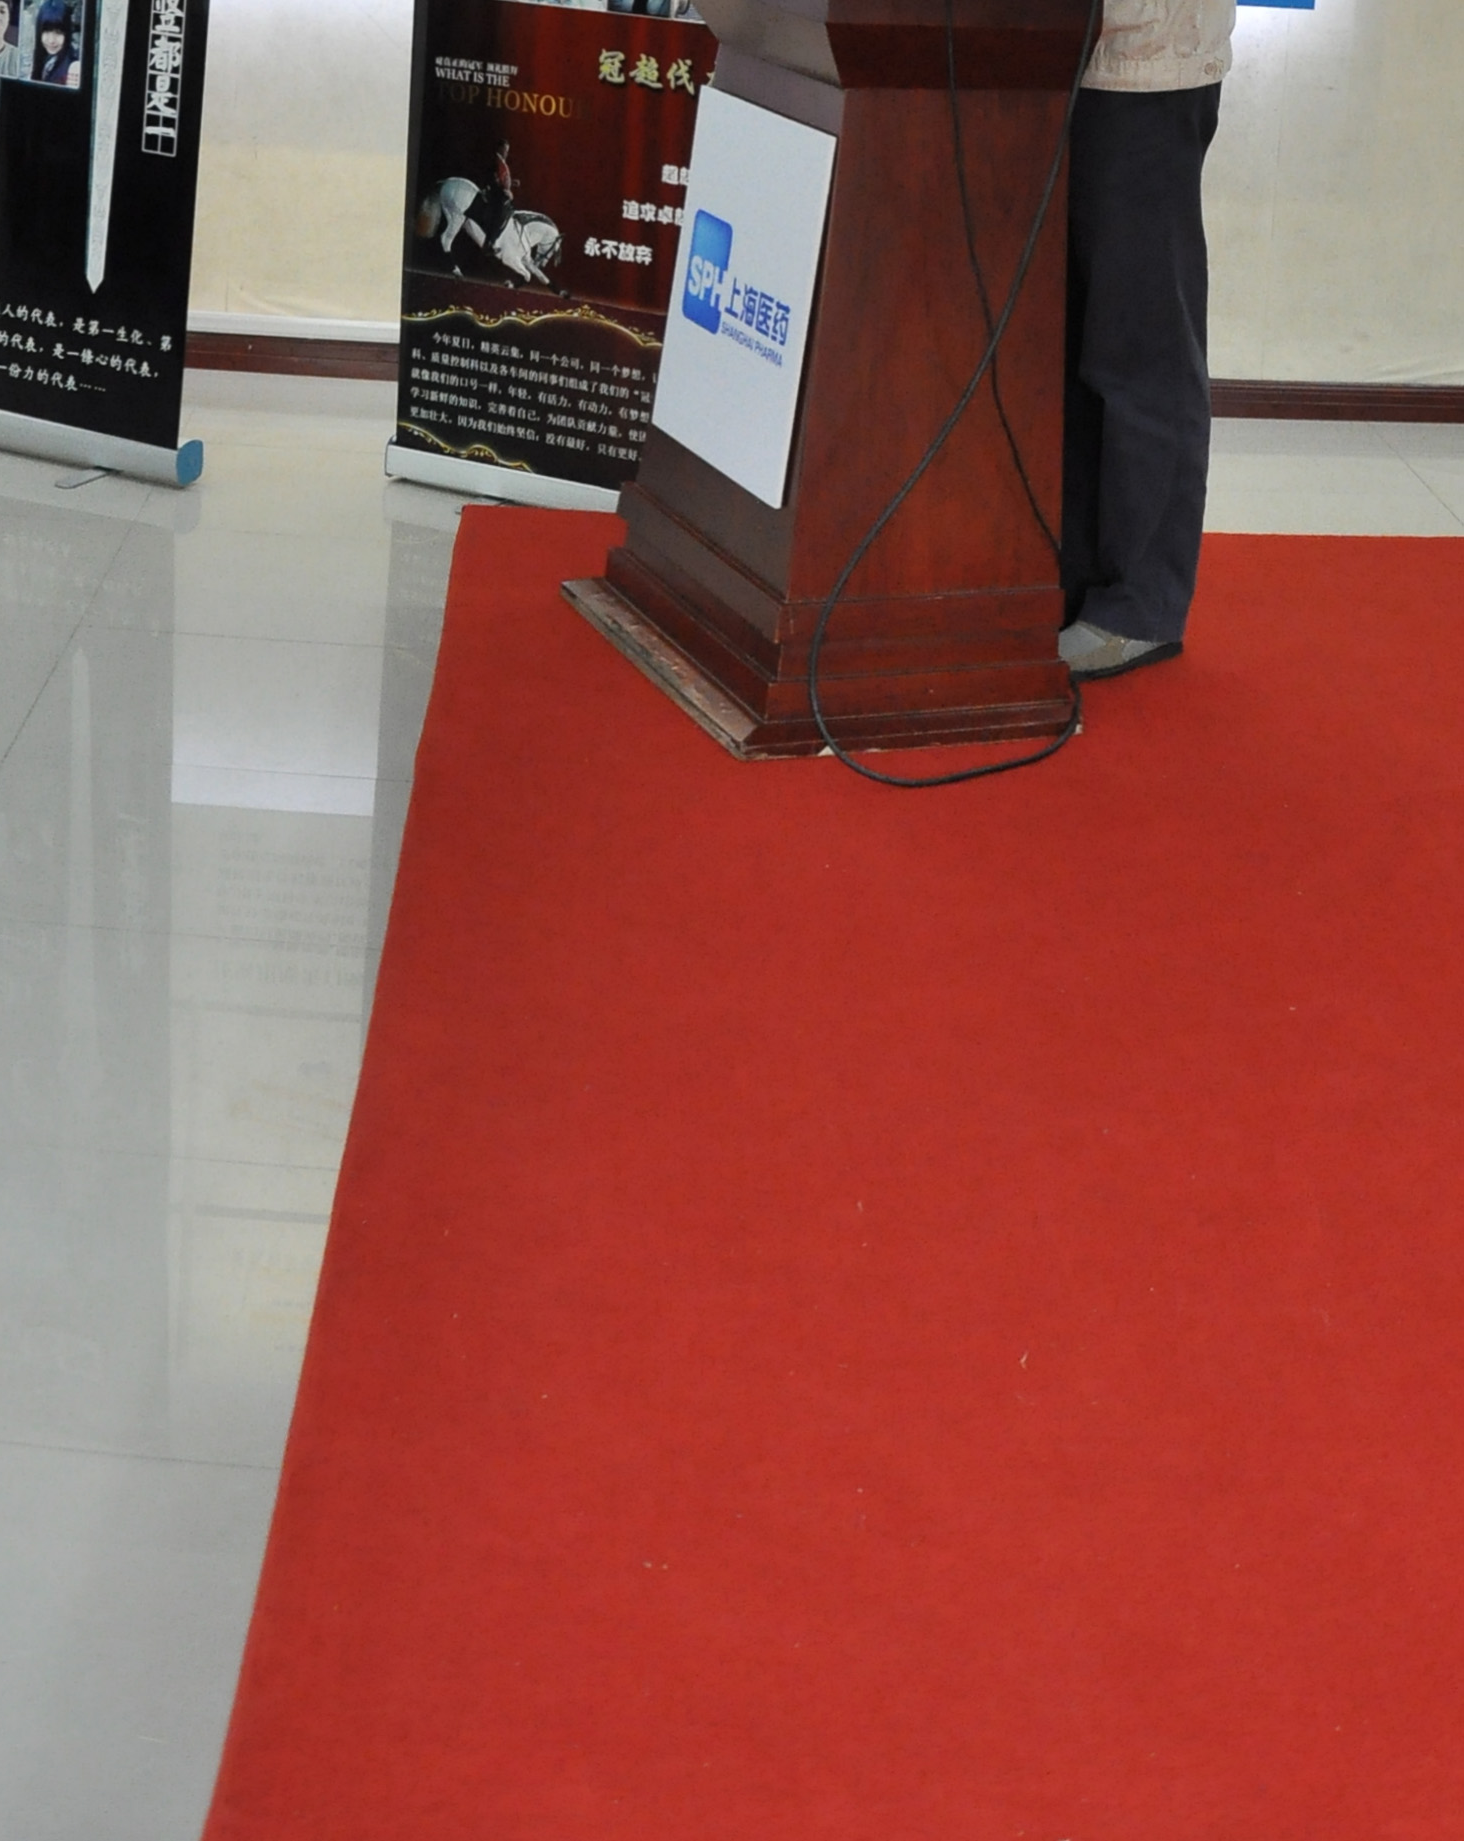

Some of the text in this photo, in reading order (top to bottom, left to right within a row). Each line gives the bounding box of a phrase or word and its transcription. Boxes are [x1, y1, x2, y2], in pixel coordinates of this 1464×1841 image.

[435, 66, 510, 88] WHAT IS THE
[584, 236, 653, 266] 永不放弃
[687, 254, 726, 308] SPH
[724, 276, 791, 347] 上海医药
[432, 332, 657, 385] 今年夏日，精英云集，同一个公司，同一个梦想，
